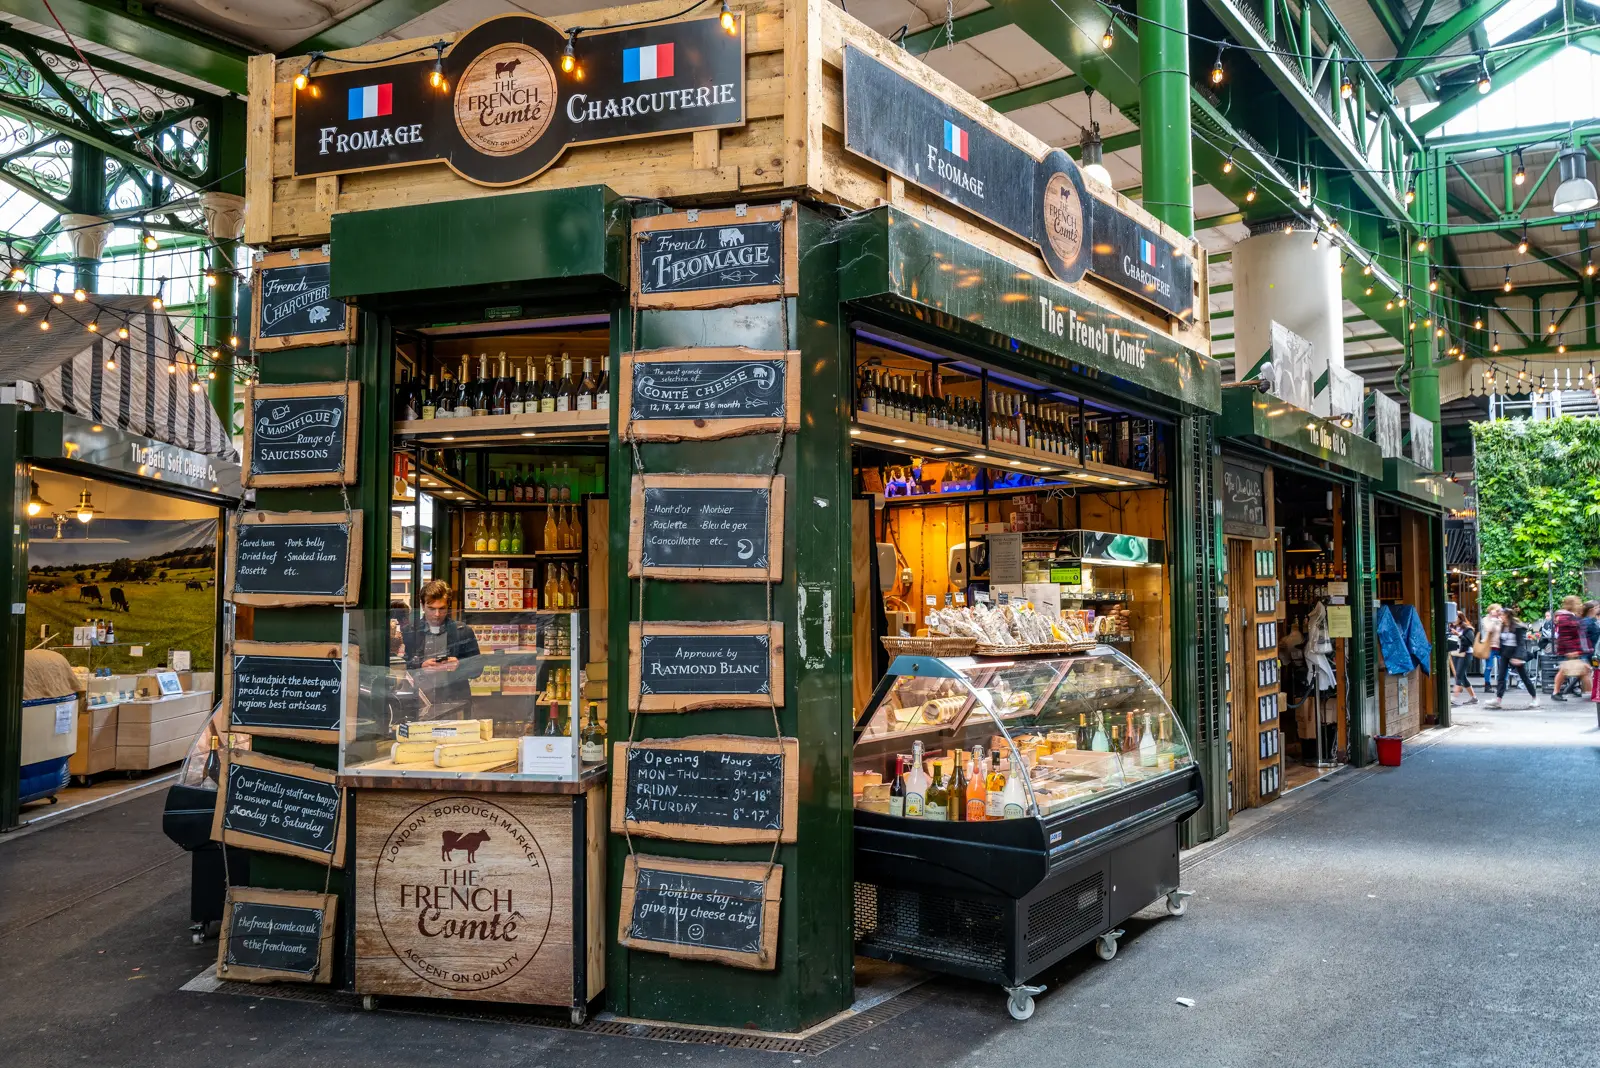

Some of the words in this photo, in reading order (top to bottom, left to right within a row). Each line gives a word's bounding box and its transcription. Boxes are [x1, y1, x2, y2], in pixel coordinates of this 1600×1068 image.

[493, 79, 518, 92] THE
[468, 87, 538, 111] FRENCH
[566, 83, 737, 123] CHARCUTERIE
[318, 123, 424, 155] FROMAGE
[476, 133, 499, 147] ACCENT
[510, 125, 535, 144] QUALITY
[927, 143, 985, 199] FROMAGE
[1049, 203, 1077, 230] FRENCH
[656, 232, 706, 253] French
[652, 246, 770, 289] FROMAGE
[1123, 254, 1171, 299] CHARCUTERIE
[265, 275, 308, 298] French
[263, 284, 331, 325] CHARCUTER
[1039, 296, 1064, 337] The
[1069, 308, 1108, 353] French
[1113, 328, 1145, 370] Comté
[665, 367, 681, 376] most
[644, 386, 689, 400] COMTÉ
[696, 370, 748, 397] CHEESE
[687, 401, 701, 410] and
[704, 401, 716, 409] 36
[258, 424, 265, 434] A
[266, 412, 331, 435] MAGNIFIQUE
[296, 433, 322, 447] Range
[324, 431, 336, 446] of
[131, 442, 145, 465] The
[148, 447, 165, 469] Bath
[168, 453, 182, 474] Soft
[184, 457, 207, 480] Cheese
[261, 448, 328, 461] SAUCISSONS
[654, 504, 674, 514] Mont
[701, 504, 734, 514] Morbier
[652, 520, 688, 529] Raclette
[701, 520, 720, 530] Bleu
[720, 519, 730, 529] de
[732, 522, 748, 533] gex
[242, 539, 260, 547] Cured
[260, 539, 276, 547] ham
[287, 538, 304, 547] Pork
[305, 536, 326, 552] belly
[651, 536, 701, 546] Cancoillotte
[241, 552, 261, 561] Dried
[261, 550, 278, 565] beef
[287, 551, 316, 562] Smoked
[316, 552, 337, 561] Ham
[240, 565, 268, 575] Rosette
[283, 566, 299, 576] etc.
[674, 646, 723, 660] Approuvé
[726, 648, 738, 661] by
[650, 662, 717, 677] RAYMOND
[719, 661, 760, 675] BLANC
[238, 673, 250, 683] We
[251, 674, 287, 687] handpick
[288, 675, 301, 686] the
[302, 676, 319, 686] best
[319, 677, 341, 694] quality
[238, 686, 279, 698] products
[281, 686, 303, 698] from
[305, 690, 321, 698] our
[237, 698, 267, 712] regions
[268, 699, 287, 709] best
[288, 700, 327, 712] artisans
[644, 751, 700, 768] Opening
[720, 754, 752, 767] Hours
[236, 775, 254, 789] Our
[253, 778, 286, 798] friendly
[285, 788, 303, 800] staff
[302, 791, 316, 802] are
[315, 792, 338, 812] happy
[636, 783, 679, 797] FRIDAY
[235, 791, 243, 801] to
[243, 794, 271, 806] answer
[271, 798, 283, 809] all
[283, 804, 301, 814] your
[301, 806, 335, 820] questions
[635, 797, 698, 814] SATURDAY
[270, 812, 280, 824] to
[281, 815, 324, 838] Saturday
[386, 815, 427, 864] LONDON
[433, 804, 499, 823] BOROUGH
[500, 818, 540, 869] MARKET
[439, 868, 480, 887] THE
[400, 884, 513, 913] FRENCH
[690, 887, 704, 900] be
[639, 900, 666, 919] give
[668, 905, 688, 922] my
[690, 907, 726, 921] cheese
[728, 912, 736, 922] a
[737, 912, 758, 929] try
[404, 948, 450, 981] ACCENT
[451, 973, 470, 983] ON
[472, 952, 520, 983] QUALITY
